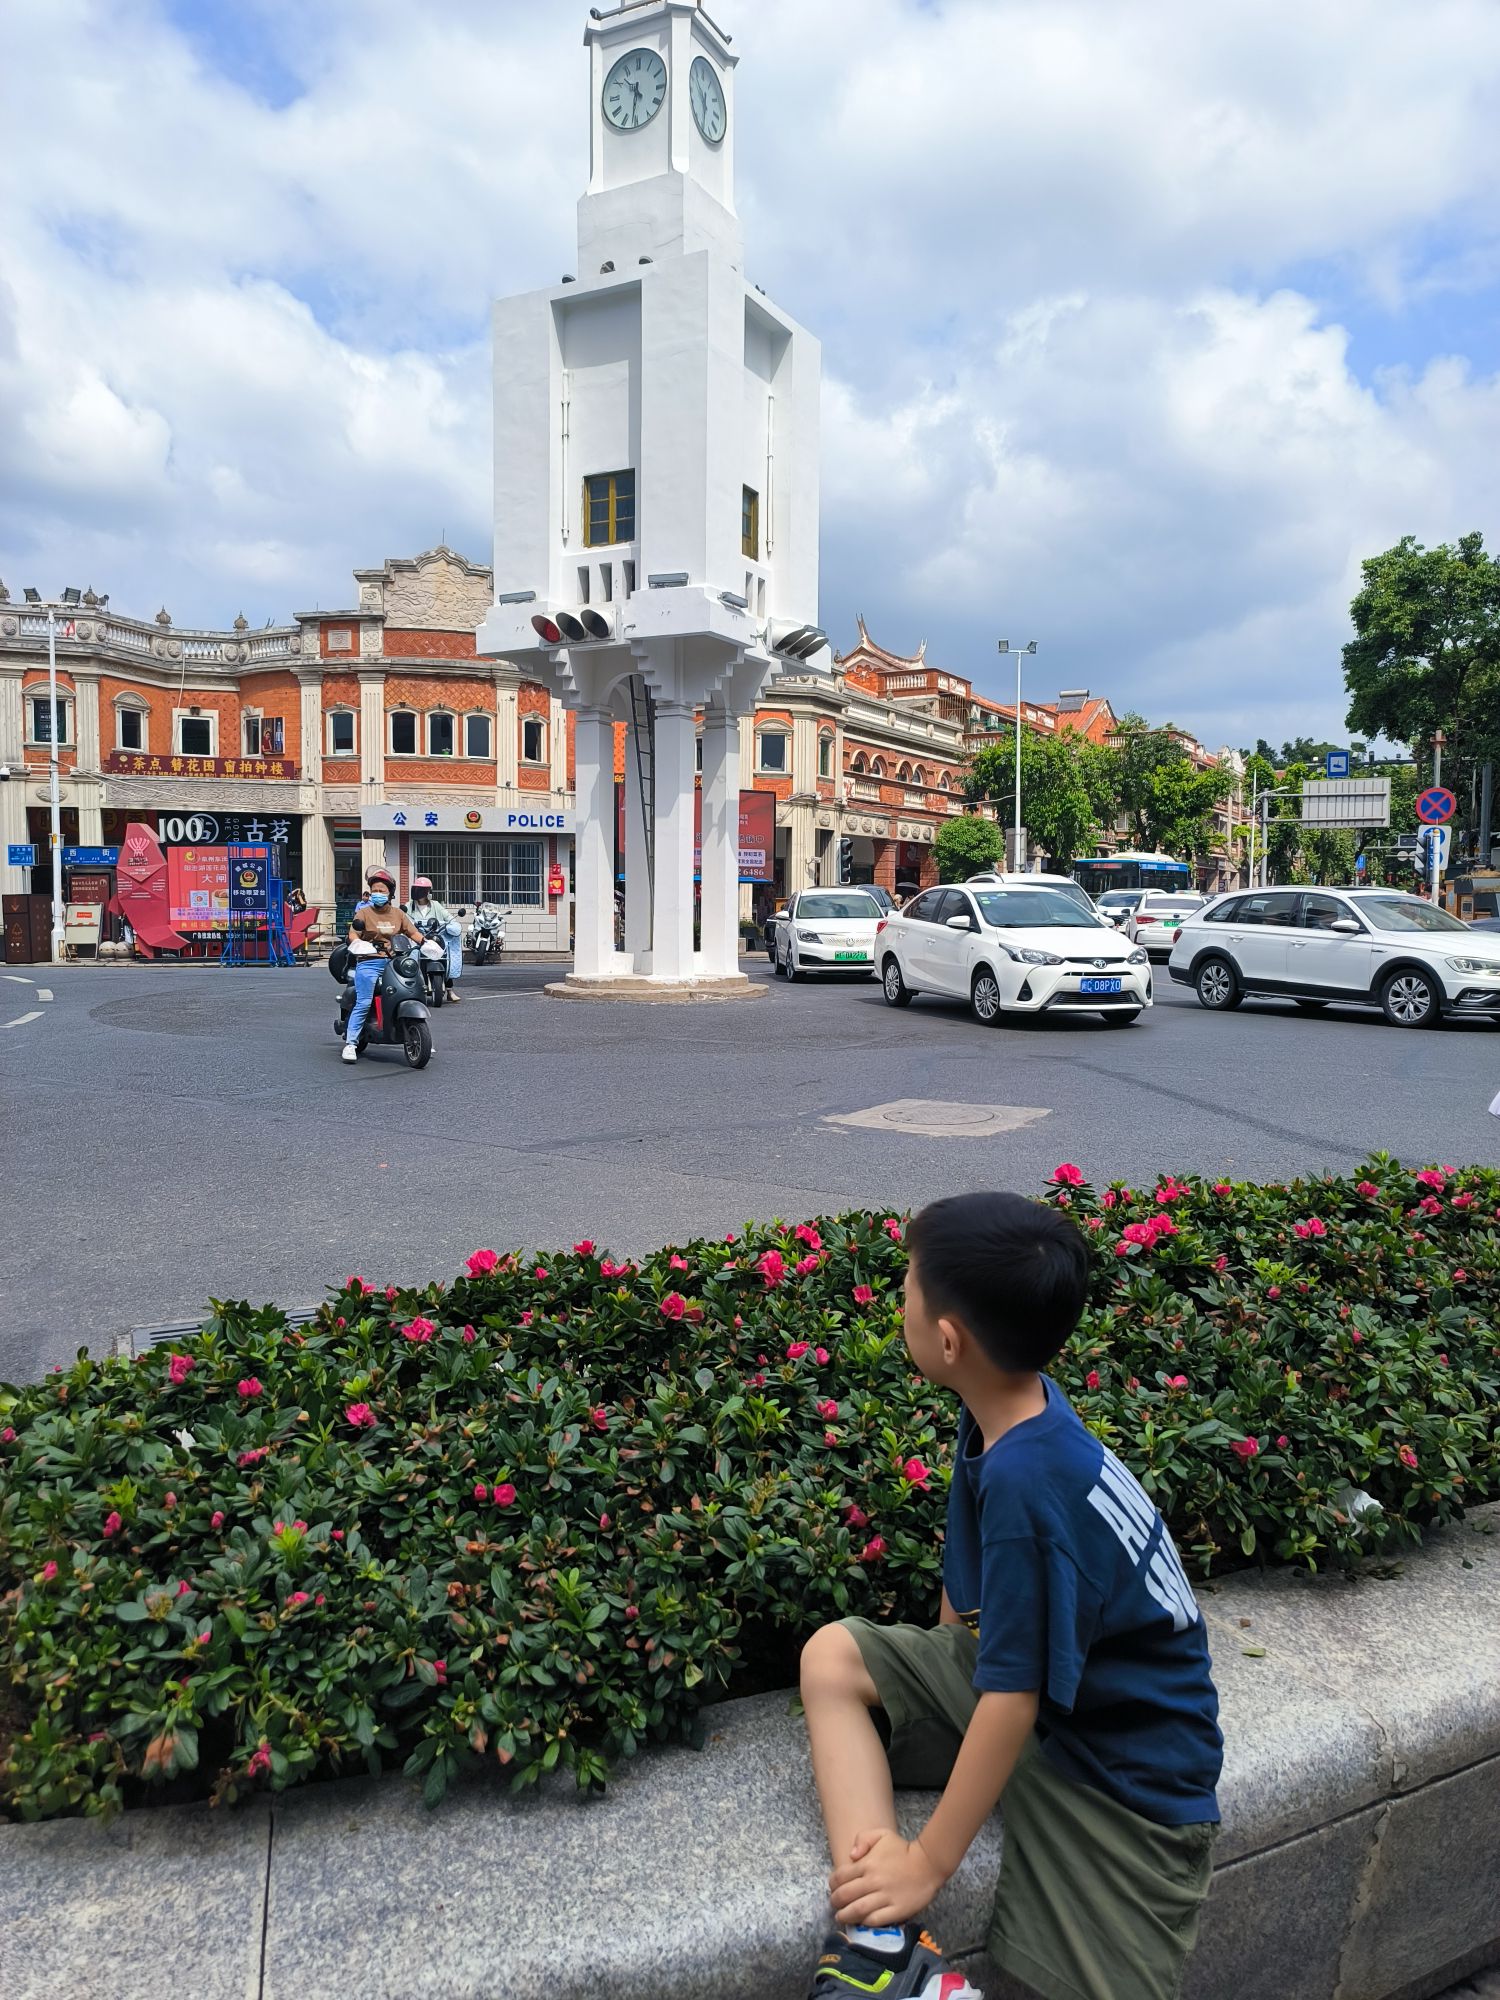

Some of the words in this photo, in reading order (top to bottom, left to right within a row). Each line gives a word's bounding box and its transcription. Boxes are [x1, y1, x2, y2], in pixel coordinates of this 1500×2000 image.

[133, 756, 162, 770] 茶点
[224, 759, 284, 775] 窗拍钟楼
[393, 811, 438, 827] 公安
[508, 814, 565, 828] POLICE
[242, 818, 292, 844] 古茗
